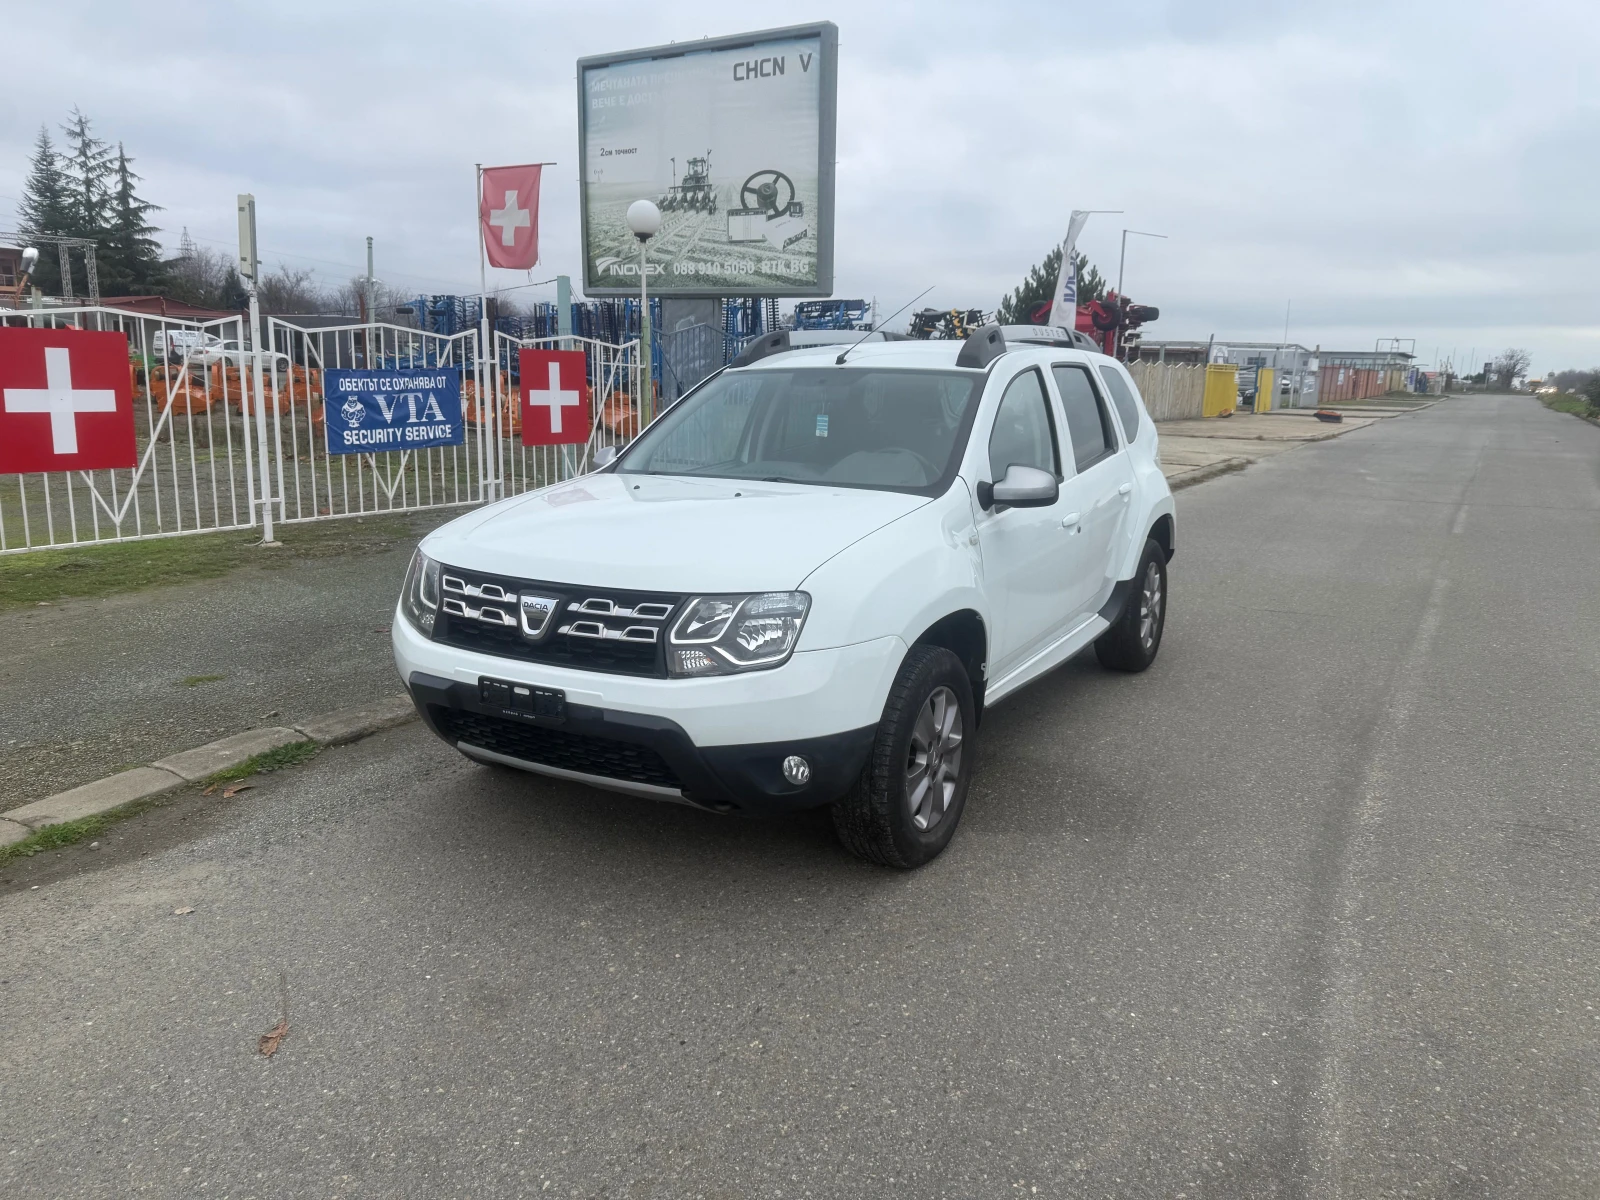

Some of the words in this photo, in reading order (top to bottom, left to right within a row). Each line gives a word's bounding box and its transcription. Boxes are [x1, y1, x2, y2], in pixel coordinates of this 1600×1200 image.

[591, 96, 616, 109] ВЕЧЕ
[610, 263, 665, 276] INOVEX
[673, 262, 696, 275] 088
[698, 262, 720, 275] 910
[724, 261, 755, 274] 5050
[761, 259, 809, 274] RTK.BG
[1032, 328, 1065, 338] DUSTER
[339, 378, 378, 392] ОБЕКТЪТ
[379, 378, 392, 390] СЕ
[392, 376, 436, 390] ОХРАНЯВА
[436, 376, 447, 388] ОТ
[373, 392, 447, 425] VTA
[343, 427, 403, 445] SECURITY
[405, 424, 453, 441] SERVICE
[523, 601, 549, 611] DACIA
